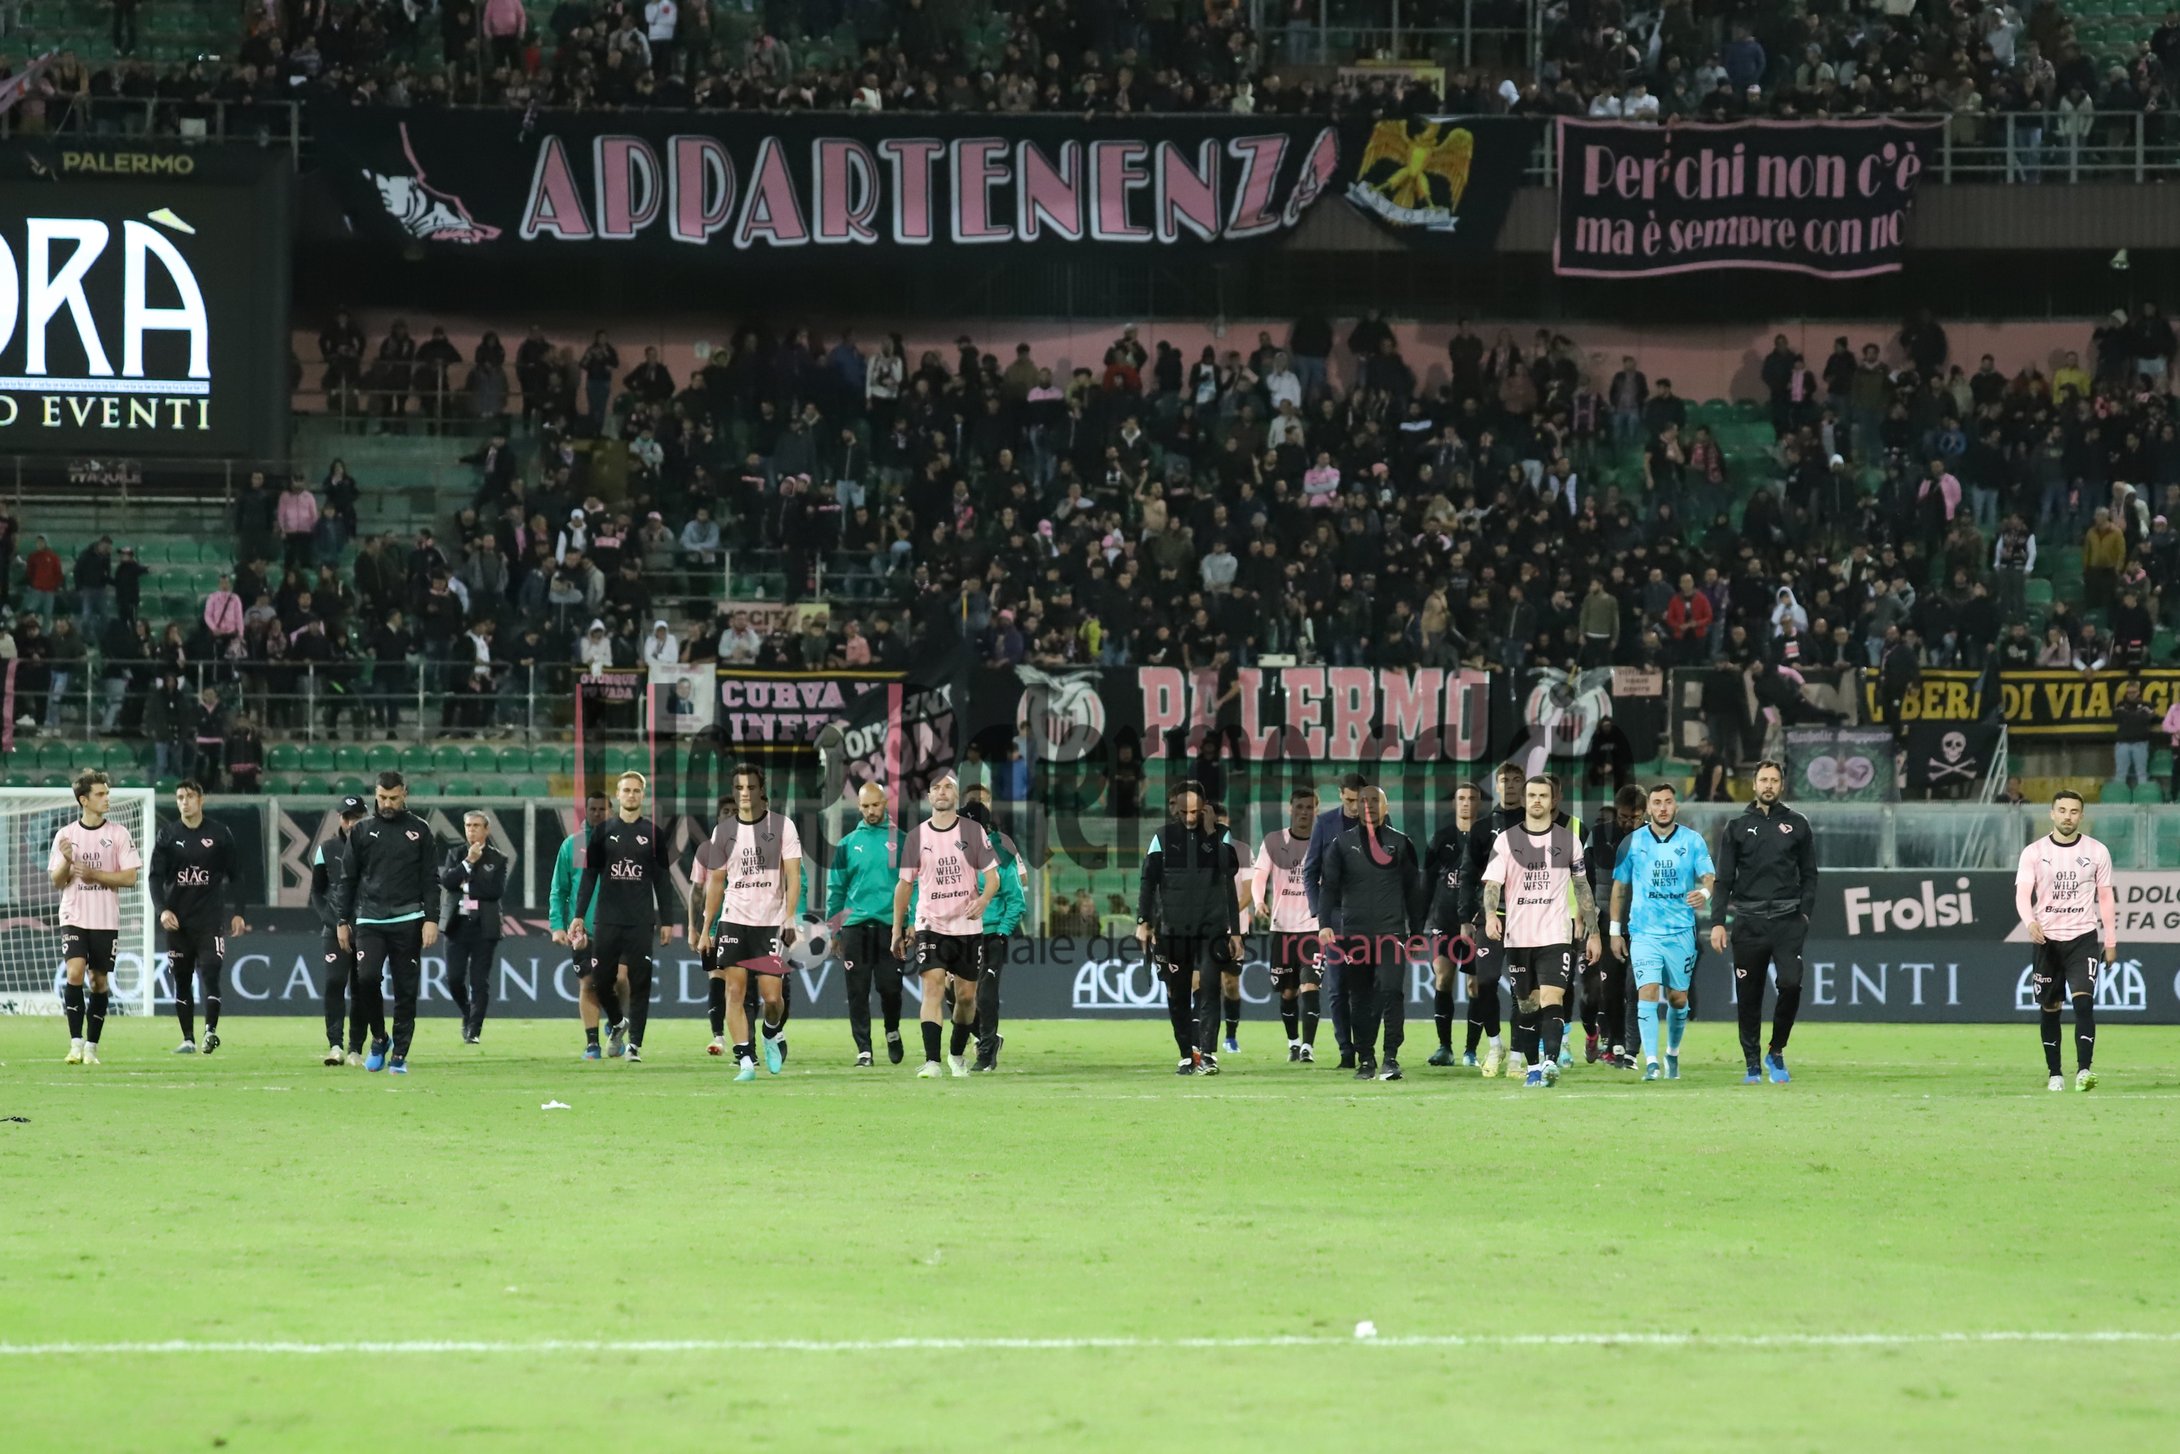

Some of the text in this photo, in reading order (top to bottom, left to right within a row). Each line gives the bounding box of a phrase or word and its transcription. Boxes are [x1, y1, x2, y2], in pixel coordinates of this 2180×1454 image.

[63, 152, 195, 174] PALERMO
[1584, 144, 1660, 199] Per
[1674, 142, 1746, 199] chi
[1756, 151, 1846, 199] non
[518, 125, 1340, 250] APPARTENENZA
[1575, 215, 1634, 256] ma
[1641, 210, 1662, 257] è
[1668, 213, 1796, 253] sempre
[1803, 216, 1863, 254] con
[41, 395, 211, 429] EVENTI
[721, 681, 847, 709] CURVA
[2002, 684, 2037, 720] DI
[1138, 666, 1491, 761] PALERMO
[82, 852, 101, 861] OLD
[742, 847, 763, 857] OLD
[741, 856, 766, 866] WILD
[938, 856, 958, 866] OLD
[1654, 860, 1674, 870] OLD
[740, 866, 767, 876] WEST
[936, 866, 961, 876] WILD
[1527, 862, 1548, 871] OLD
[1524, 871, 1550, 881] WILD
[1652, 869, 1677, 879] WILD
[2056, 871, 2077, 881] OLD
[935, 875, 963, 886] WEST
[1523, 880, 1551, 891] WEST
[1651, 878, 1679, 888] WEST
[2053, 881, 2079, 890] WILD
[930, 890, 970, 900] Bisaten
[2052, 890, 2079, 900] WEST
[1843, 876, 1974, 936] Frolsi
[2045, 905, 2085, 914] Bisaten
[2126, 911, 2156, 930] FA
[214, 935, 226, 953] 18
[1562, 952, 1572, 972] 9
[2087, 957, 2098, 976] 17
